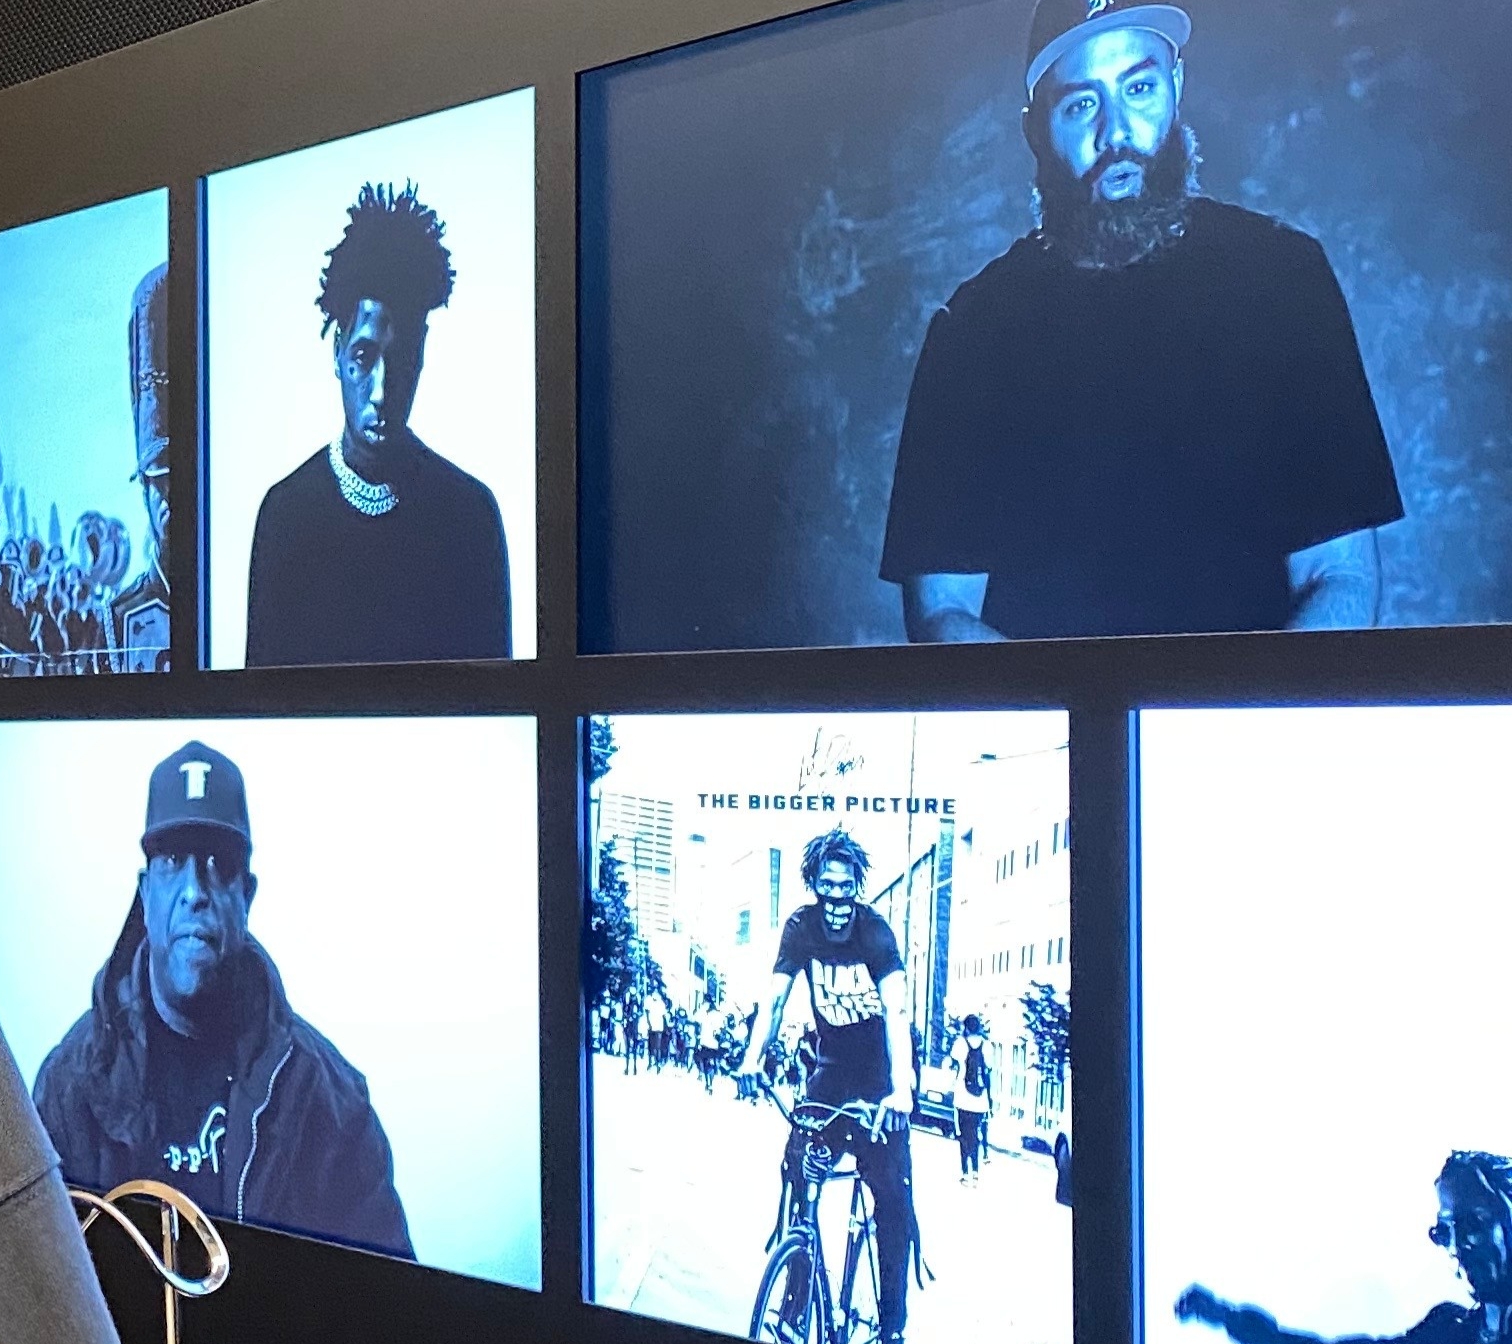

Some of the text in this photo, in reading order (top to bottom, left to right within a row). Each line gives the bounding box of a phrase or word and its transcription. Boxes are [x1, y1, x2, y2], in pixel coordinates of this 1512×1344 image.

[697, 793, 957, 815] THE BIGGER PICTURE
